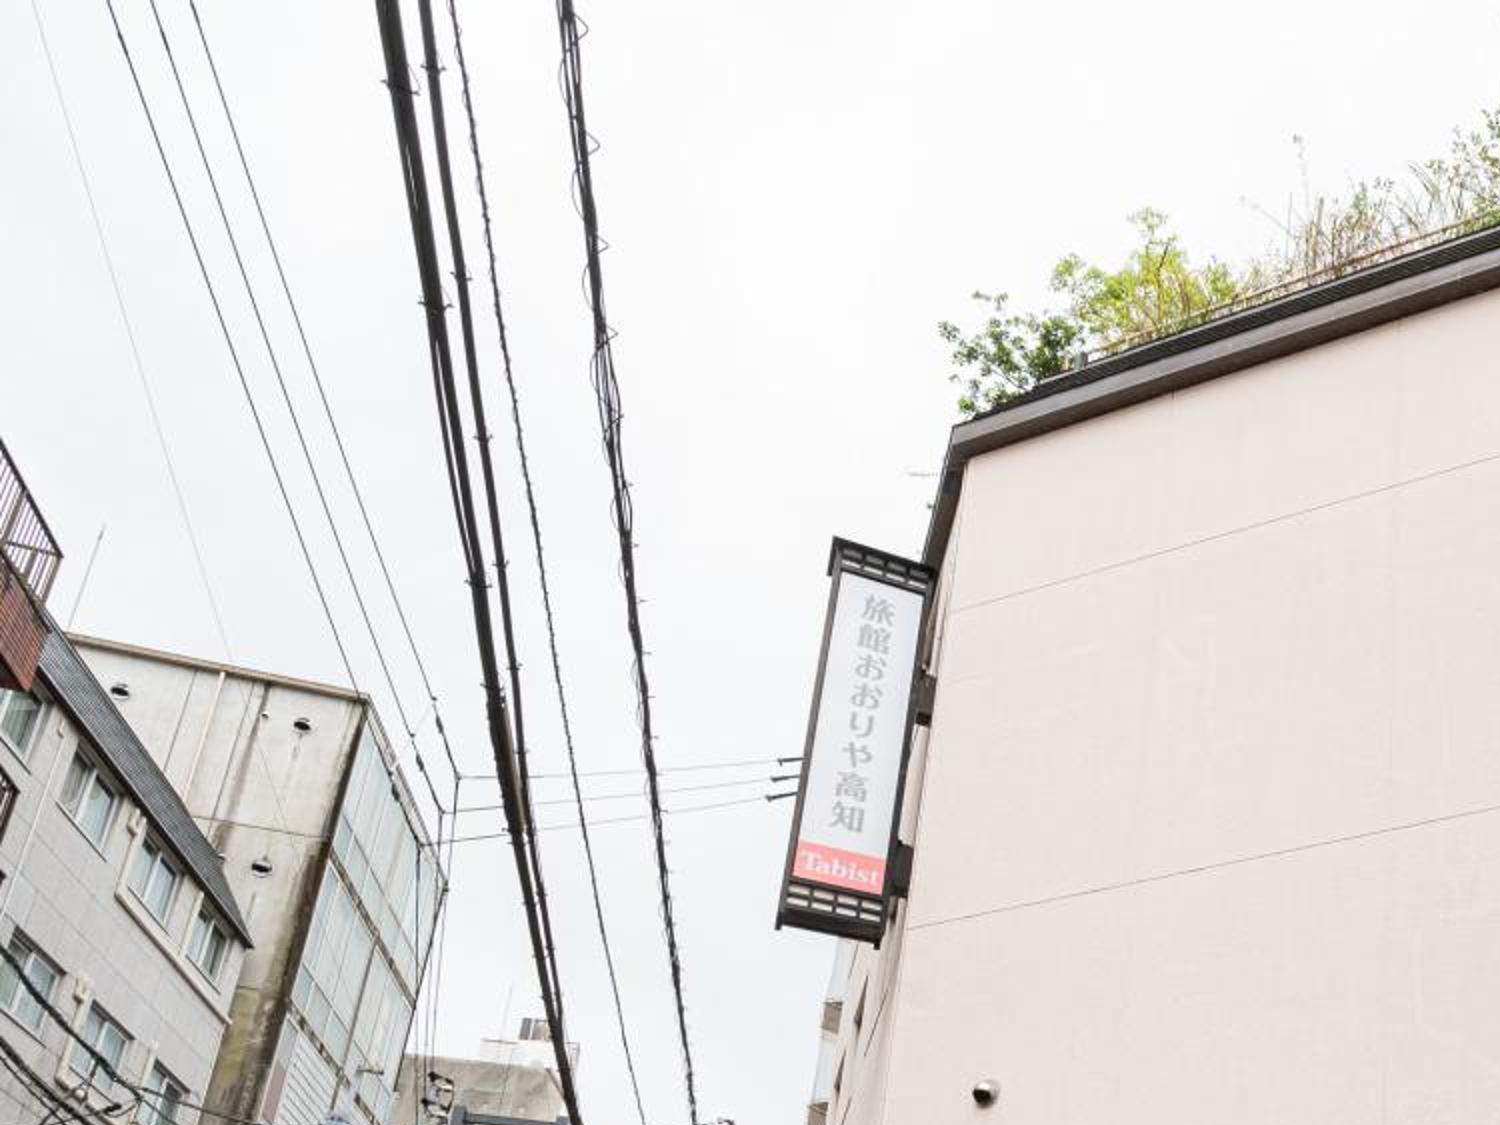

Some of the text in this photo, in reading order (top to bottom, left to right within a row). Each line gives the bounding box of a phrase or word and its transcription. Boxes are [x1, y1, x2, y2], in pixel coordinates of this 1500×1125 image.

[828, 593, 895, 834] 旅館おおりや高知
[801, 849, 879, 887] Tabist
